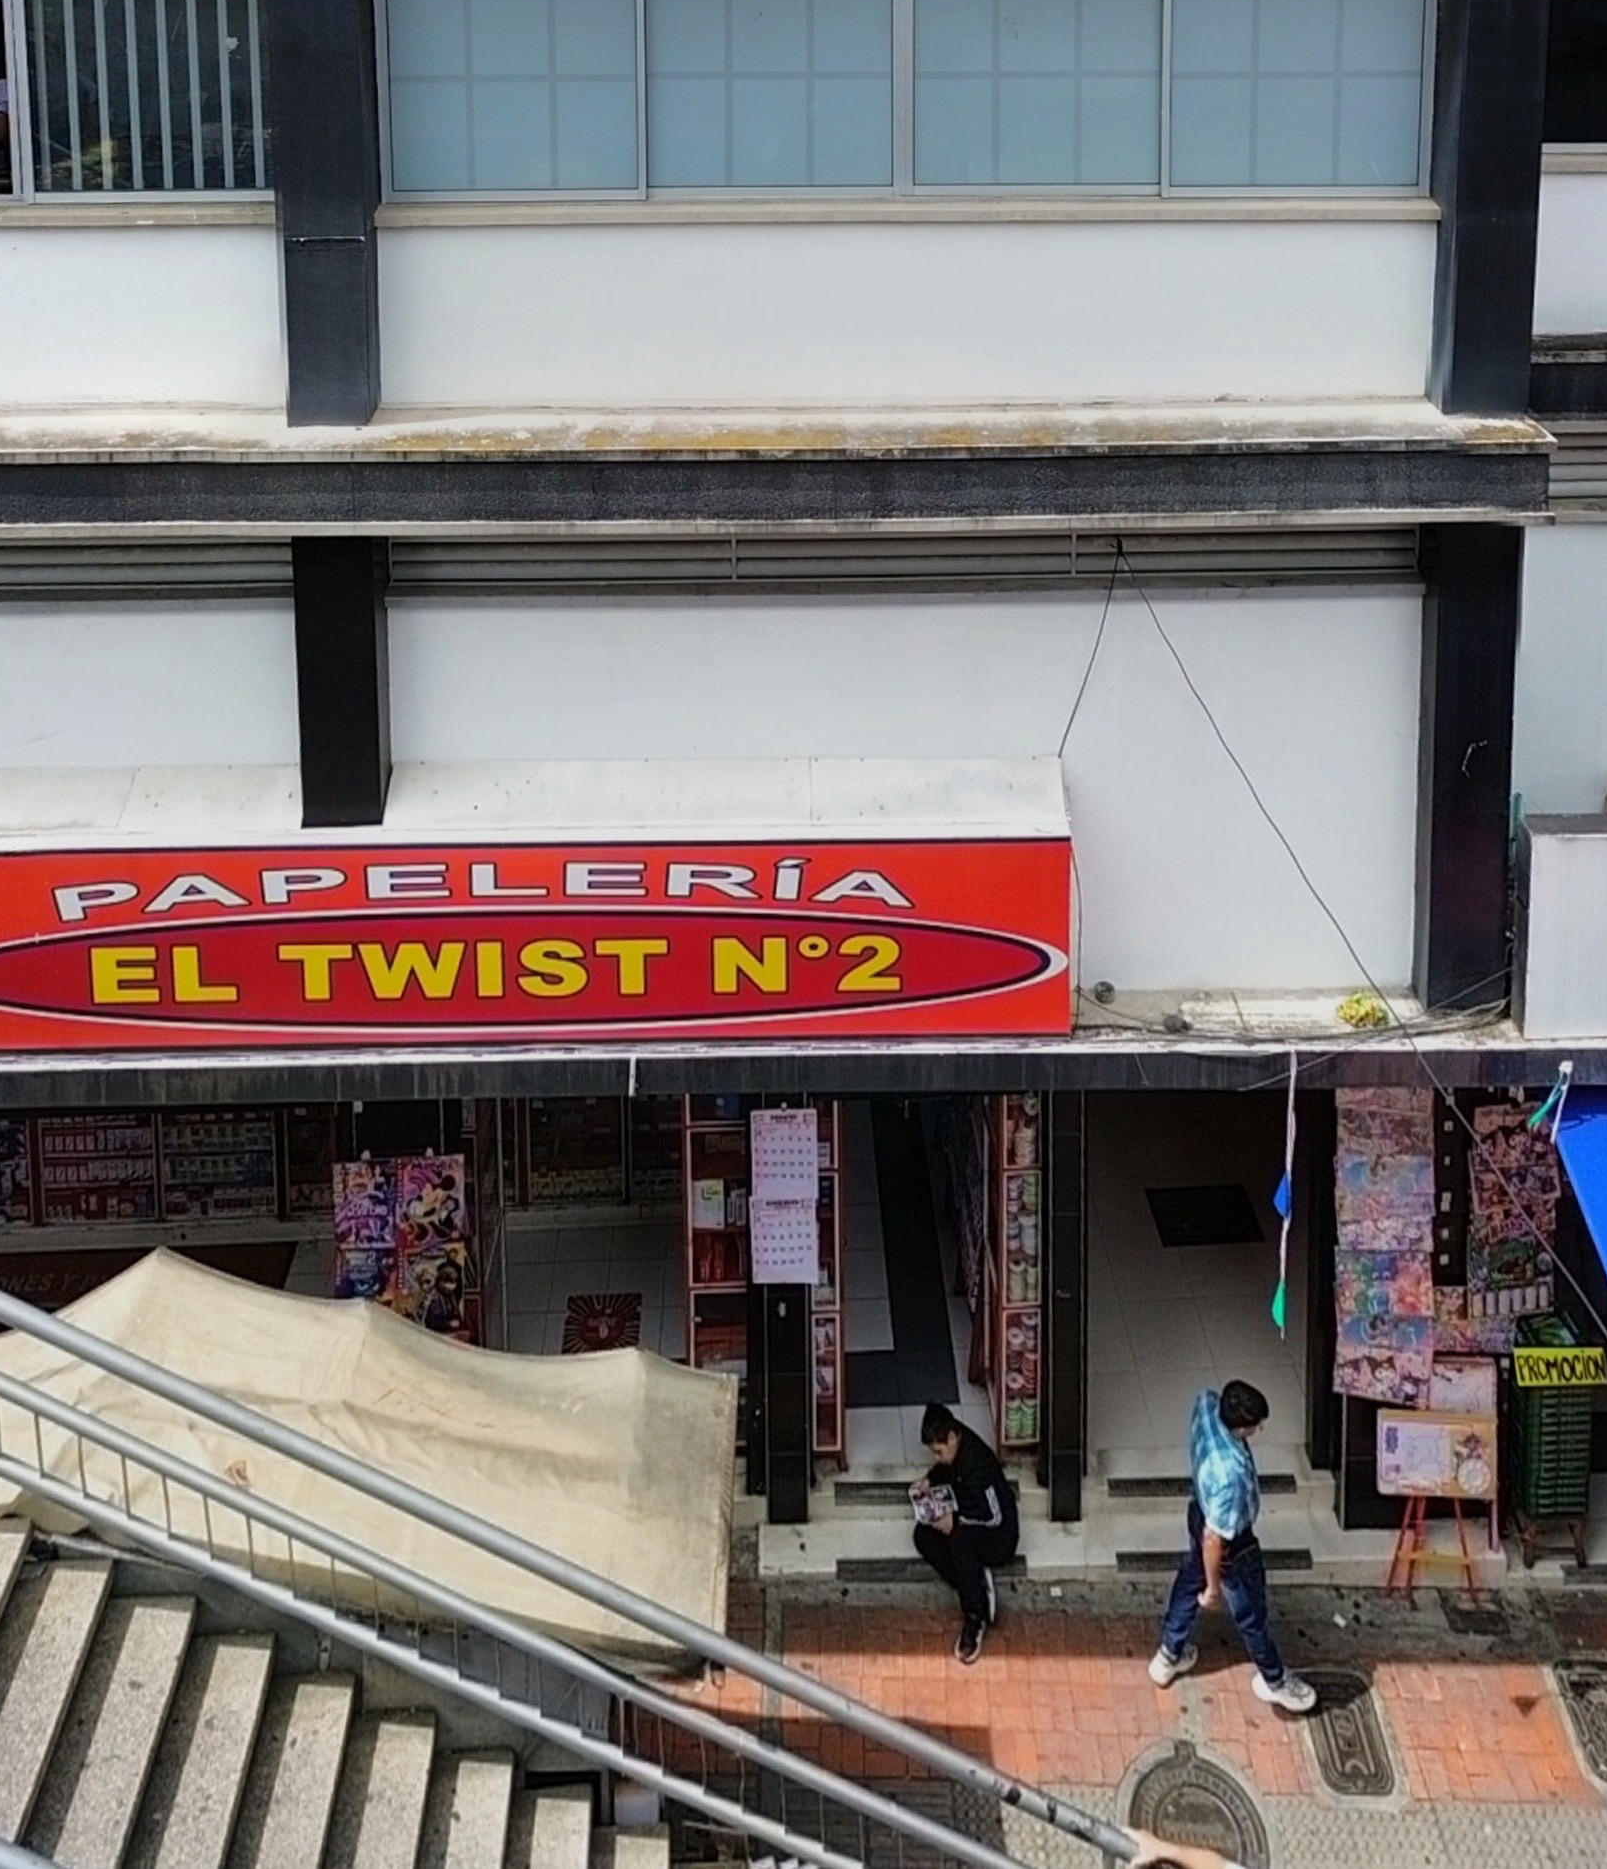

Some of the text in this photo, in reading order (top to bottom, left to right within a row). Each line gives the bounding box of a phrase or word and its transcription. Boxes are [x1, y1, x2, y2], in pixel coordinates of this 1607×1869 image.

[50, 858, 916, 923] PAPELERÍA
[88, 942, 239, 1005] EL
[277, 936, 670, 1003] TWIST
